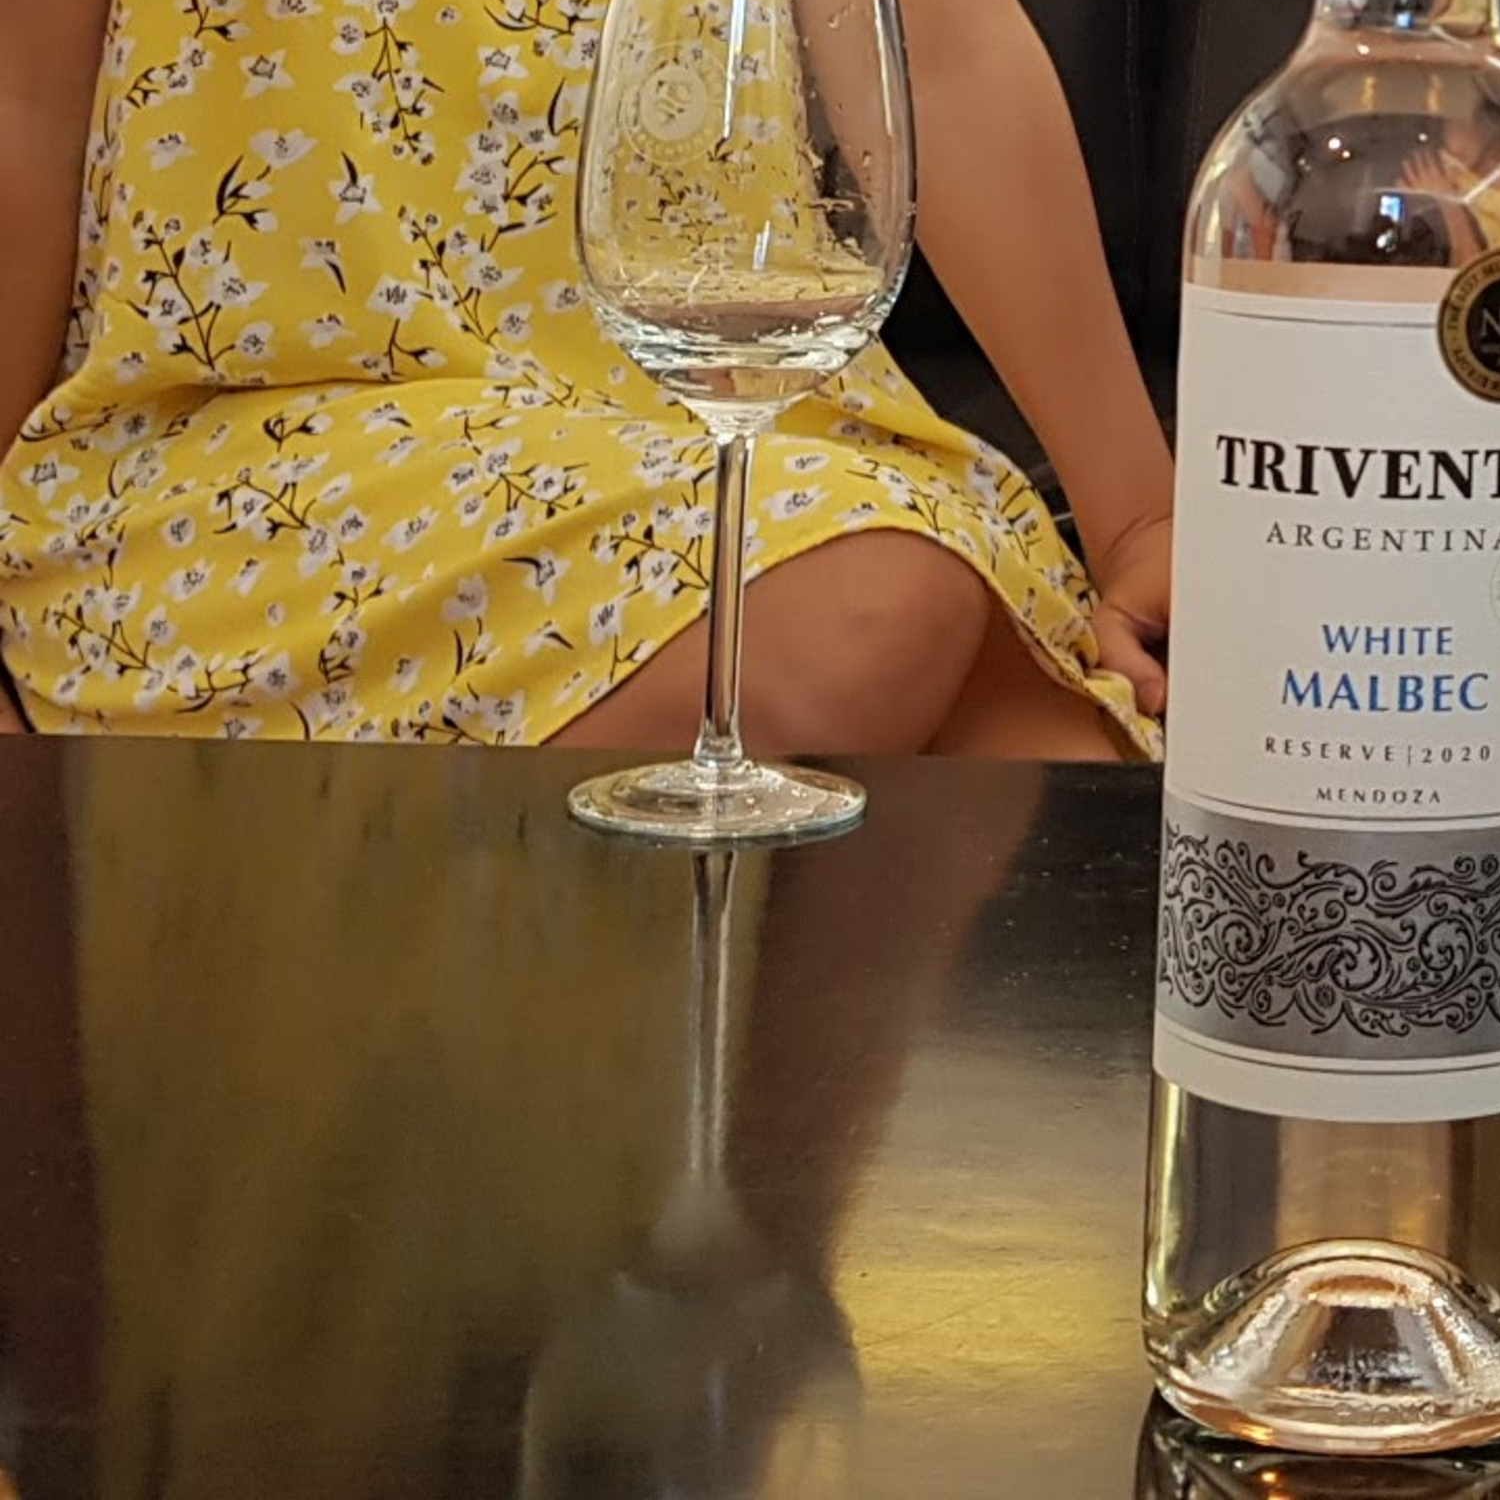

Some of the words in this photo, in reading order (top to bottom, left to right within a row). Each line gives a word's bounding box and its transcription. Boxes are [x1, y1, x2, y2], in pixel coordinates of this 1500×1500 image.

[1321, 623, 1454, 657] WHITE
[1280, 668, 1489, 714] MALBEC
[1316, 787, 1442, 805] MENDOZA
